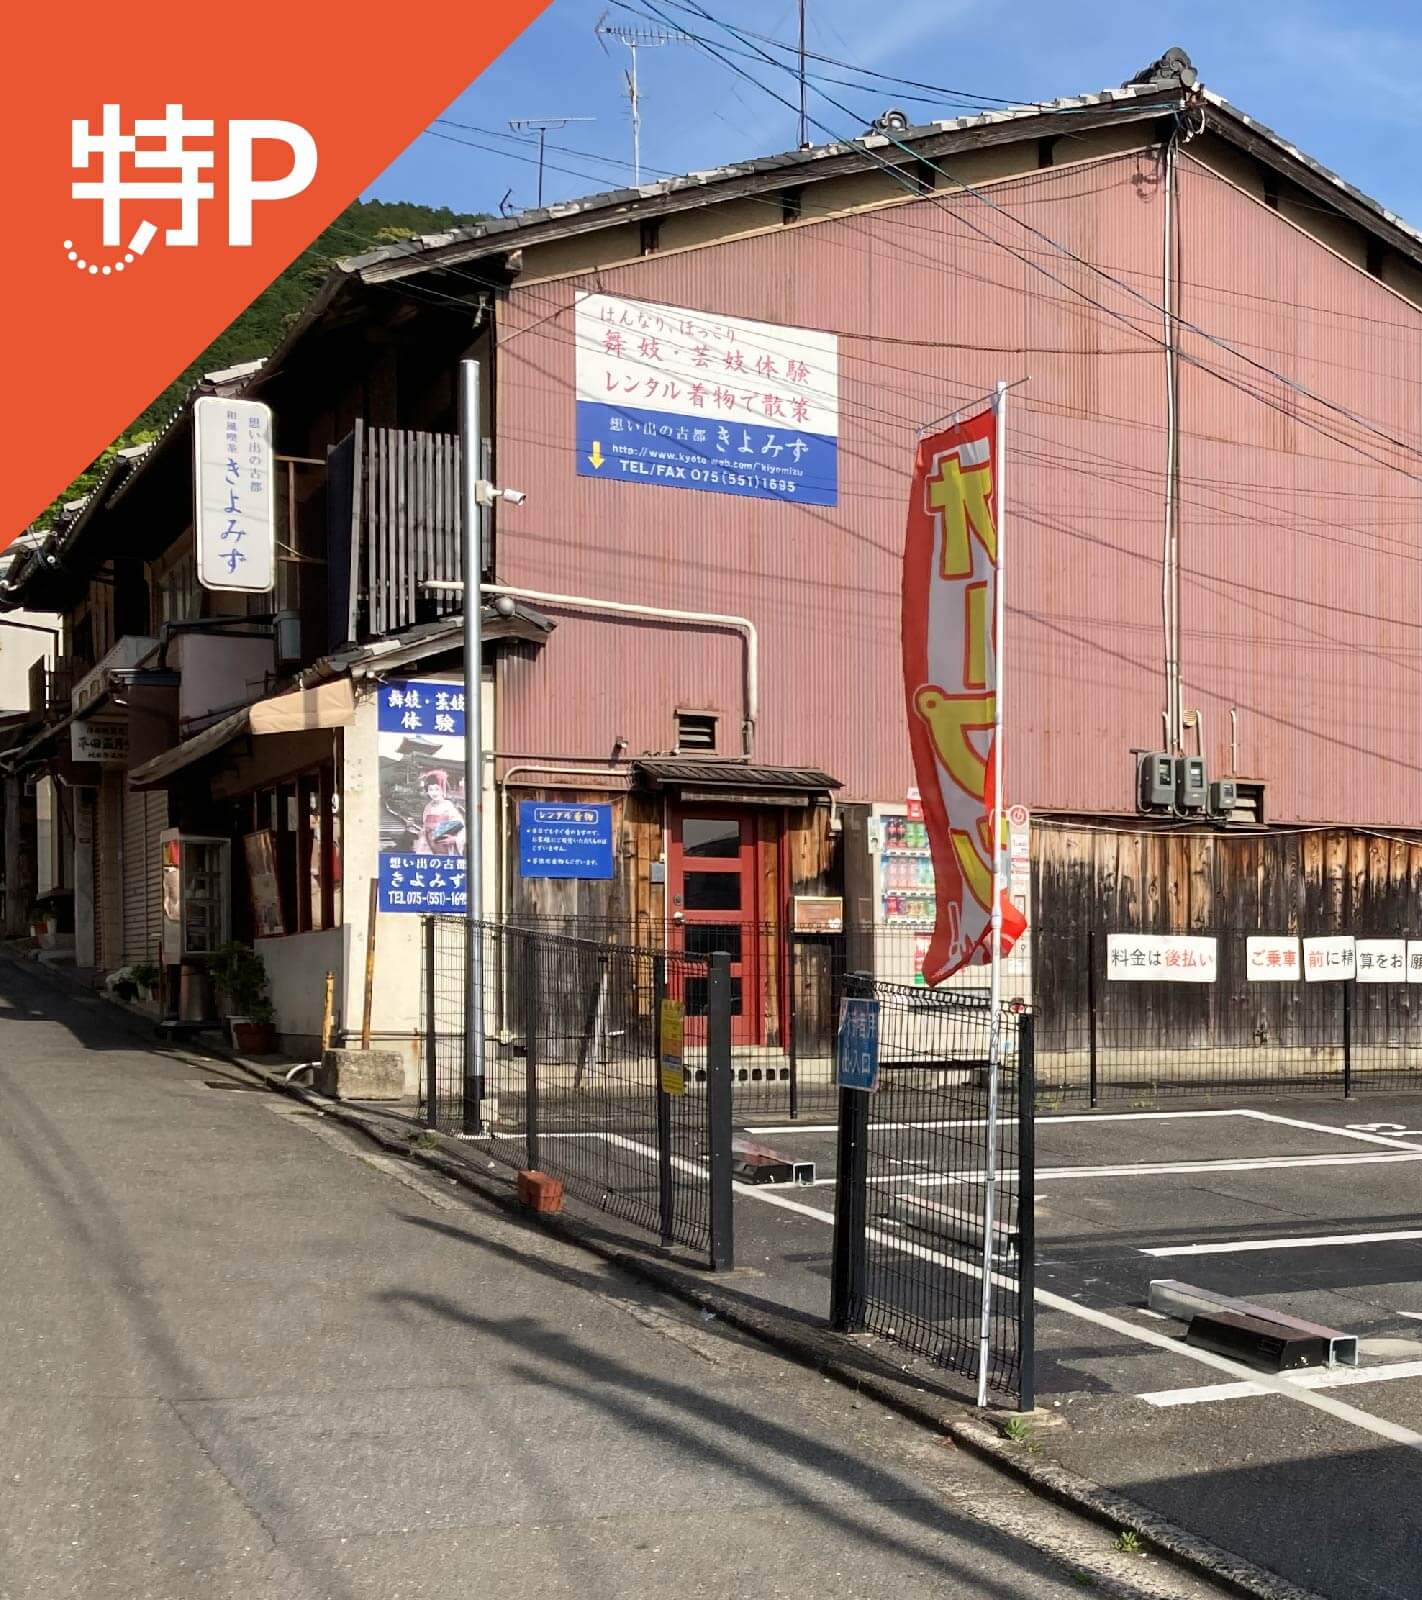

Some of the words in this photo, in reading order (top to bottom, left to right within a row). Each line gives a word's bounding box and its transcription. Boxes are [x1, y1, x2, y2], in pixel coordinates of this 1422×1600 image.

[602, 329, 811, 385] 舞妓・芸妓体験
[605, 369, 811, 423] レンタル着物で散策
[609, 416, 708, 443] 想い出の古都
[715, 424, 810, 463] きよみず
[619, 458, 687, 480] TEL/FAX
[218, 457, 247, 574] きよみず
[401, 712, 456, 733] 体験
[391, 871, 465, 889] きよみず
[1111, 948, 1214, 968] 料金は後払い
